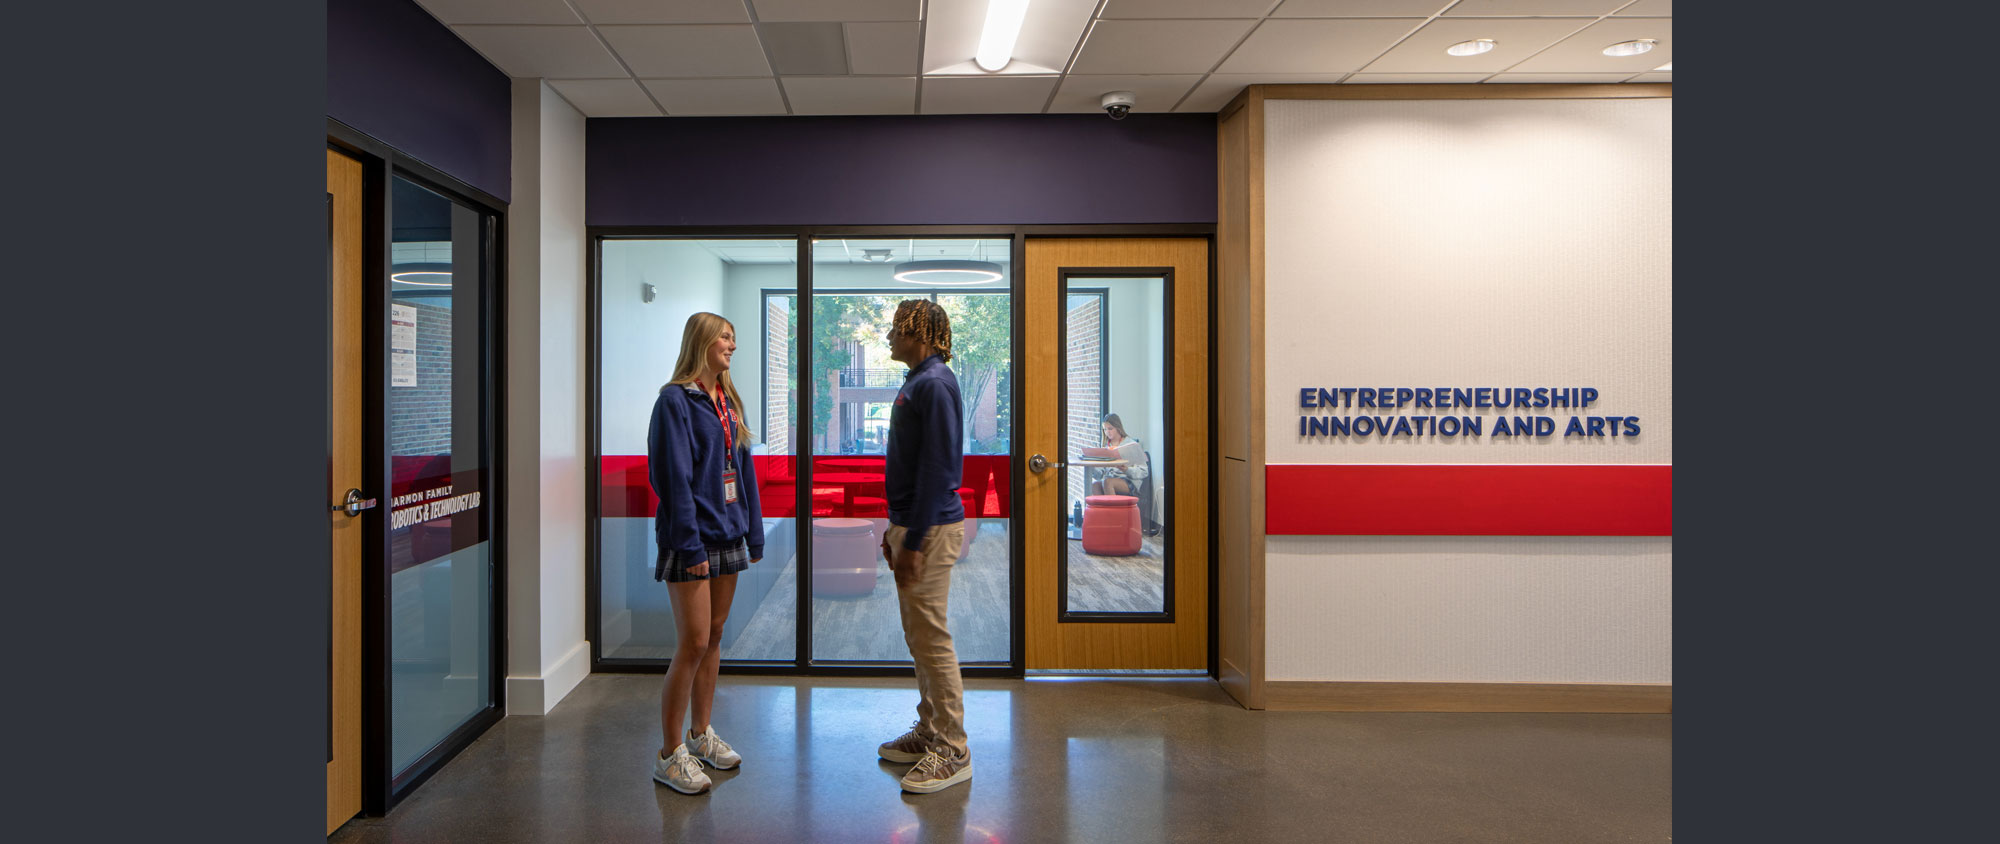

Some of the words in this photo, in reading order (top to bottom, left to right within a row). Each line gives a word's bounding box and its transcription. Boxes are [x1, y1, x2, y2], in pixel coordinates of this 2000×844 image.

[1300, 387, 1599, 408] ENTREPRENEURSHIP
[1300, 416, 1483, 436] INNOVATION
[1491, 416, 1556, 436] AND
[1564, 416, 1641, 436] ARTS
[426, 485, 453, 499] FAMILY
[424, 503, 430, 521] &
[430, 494, 469, 519] TECHNOLOGY
[467, 491, 481, 509] LAB
